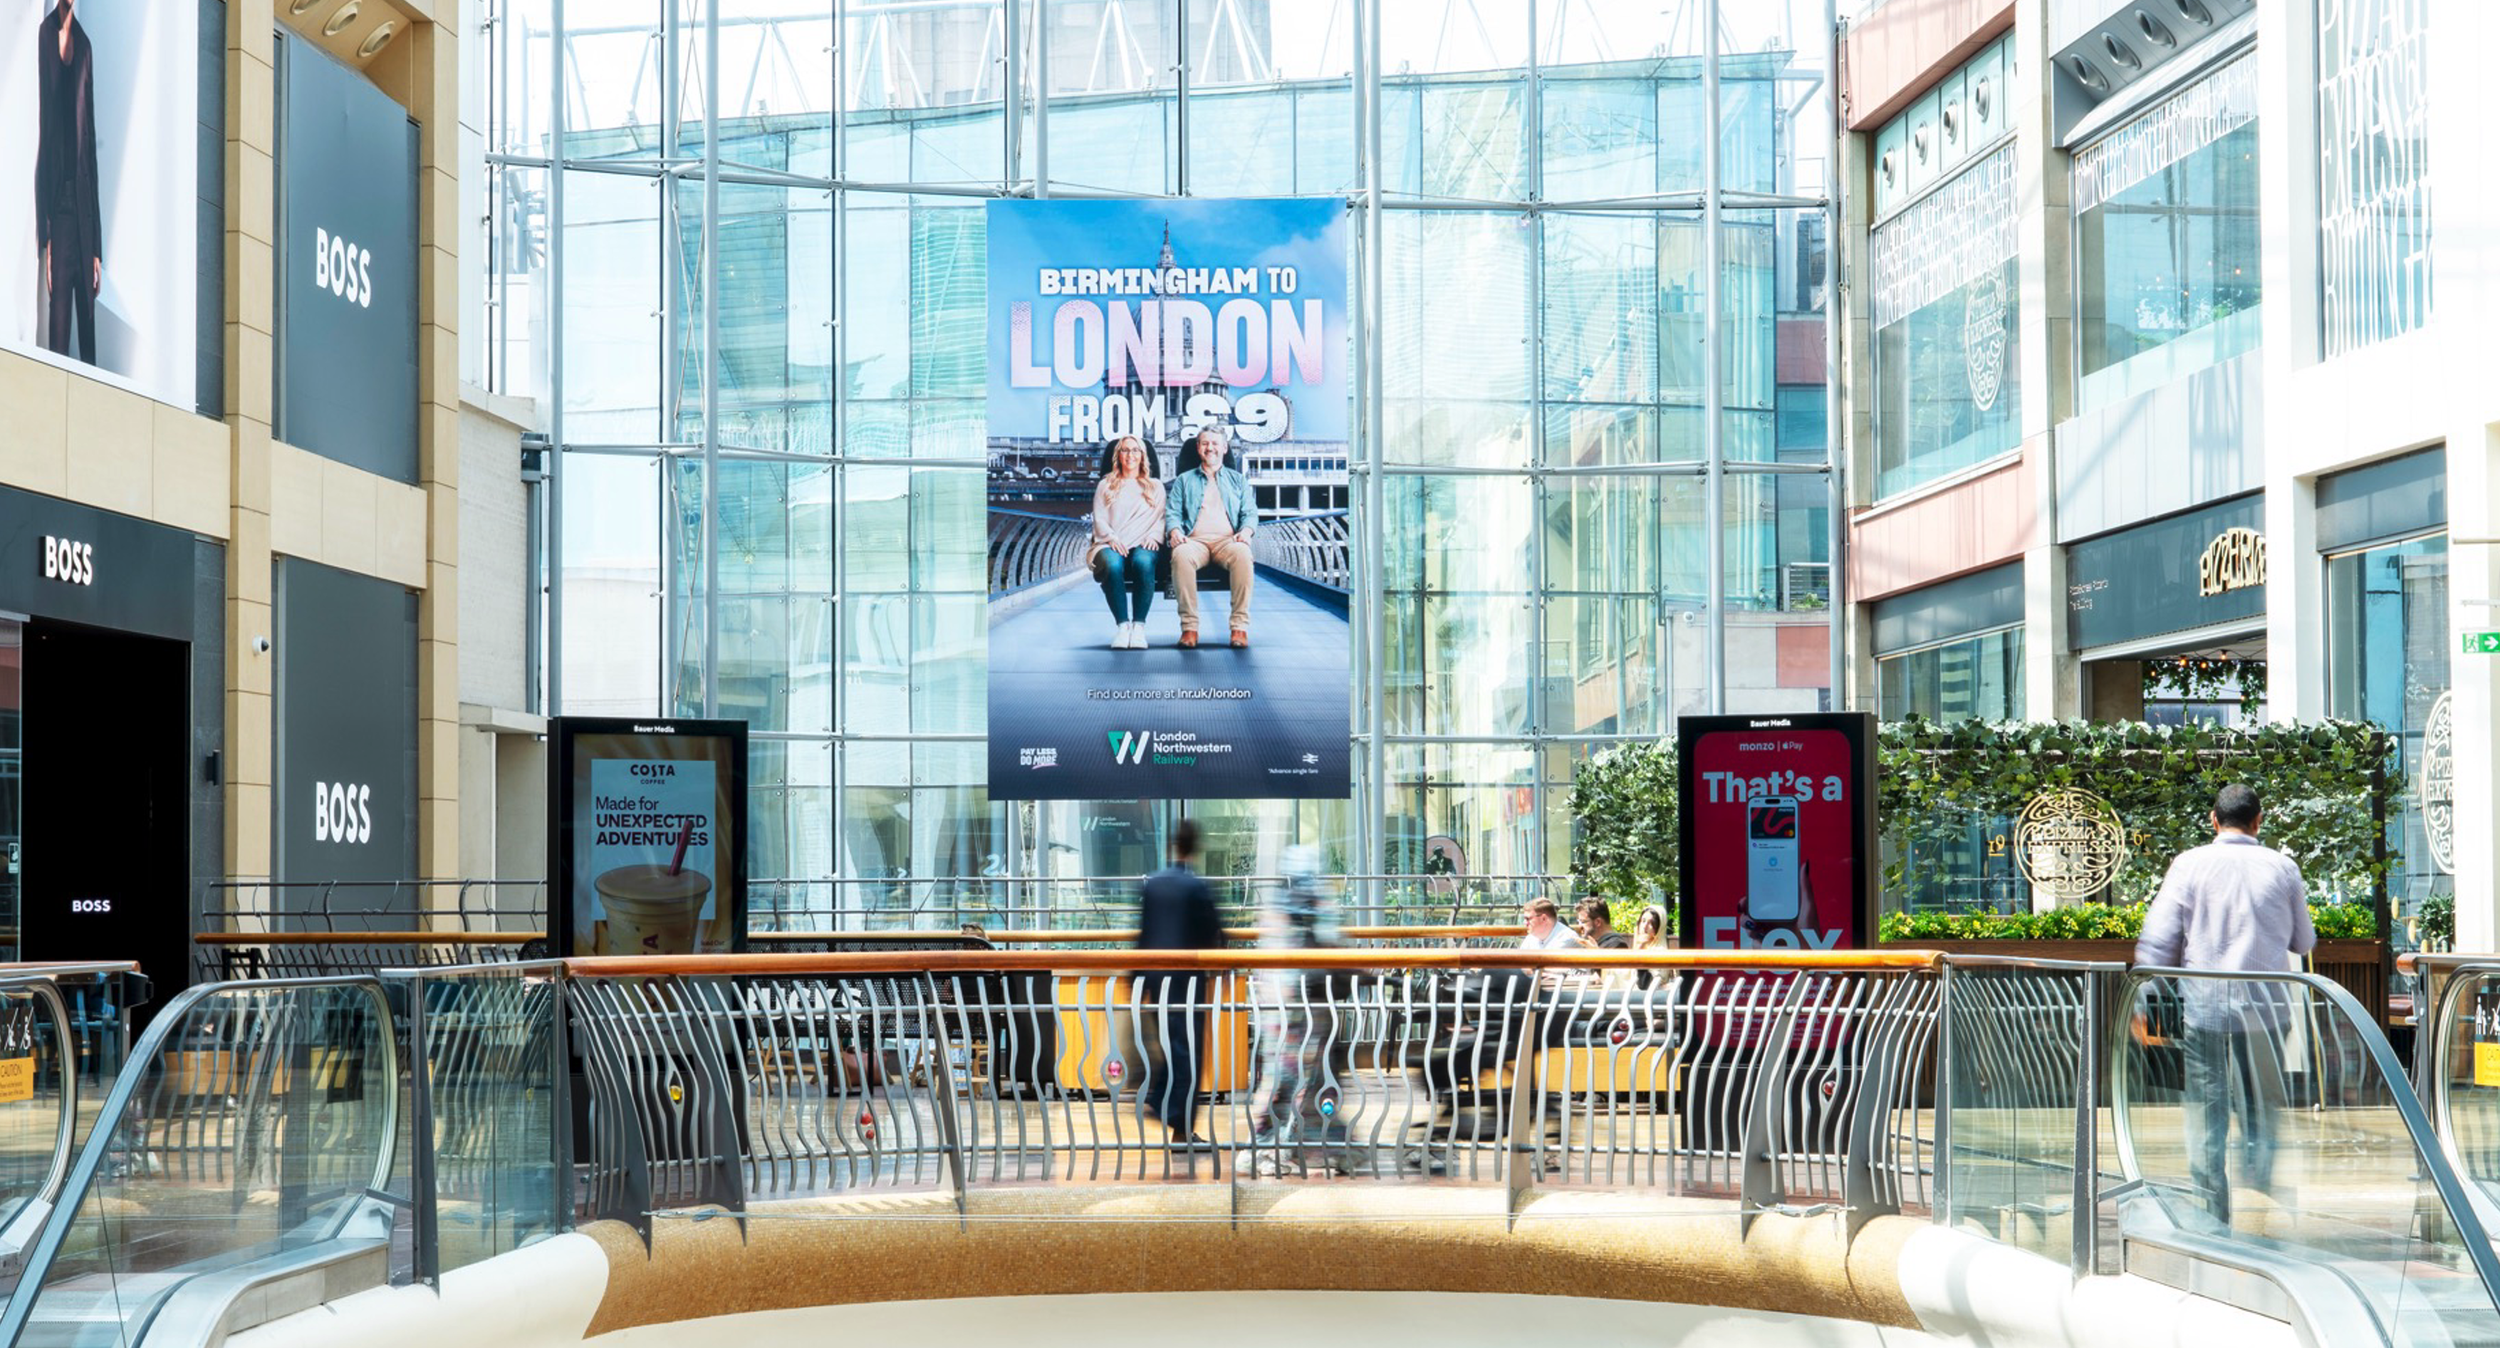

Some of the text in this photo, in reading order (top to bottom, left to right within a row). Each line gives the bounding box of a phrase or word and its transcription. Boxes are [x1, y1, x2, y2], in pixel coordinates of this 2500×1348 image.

[316, 226, 371, 309] BOSS
[1040, 266, 1298, 296] BIRMINGHAM TO
[1010, 298, 1323, 389] LONDON
[1048, 392, 1290, 444] FROM £9
[44, 535, 93, 587] BOSS
[1087, 687, 1252, 701] Find out more at lnr.uk/london
[633, 725, 675, 734] Bauer Media
[1750, 718, 1791, 728] Bauer Media
[1153, 730, 1197, 742] London
[1020, 748, 1057, 756] PAY LESS
[1153, 742, 1232, 753] Northwestern
[1739, 741, 1804, 752] monzo Pay
[1020, 755, 1058, 766] DO MORE
[1153, 753, 1197, 767] Railway
[630, 764, 676, 778] COSTA
[1292, 767, 1308, 775] single
[1702, 770, 1844, 803] That's a
[596, 796, 660, 811] Made for
[316, 781, 371, 844] BOSS
[2043, 826, 2097, 841] PIZZA
[2027, 840, 2115, 854] EXPRESS
[72, 900, 111, 912] BOSS
